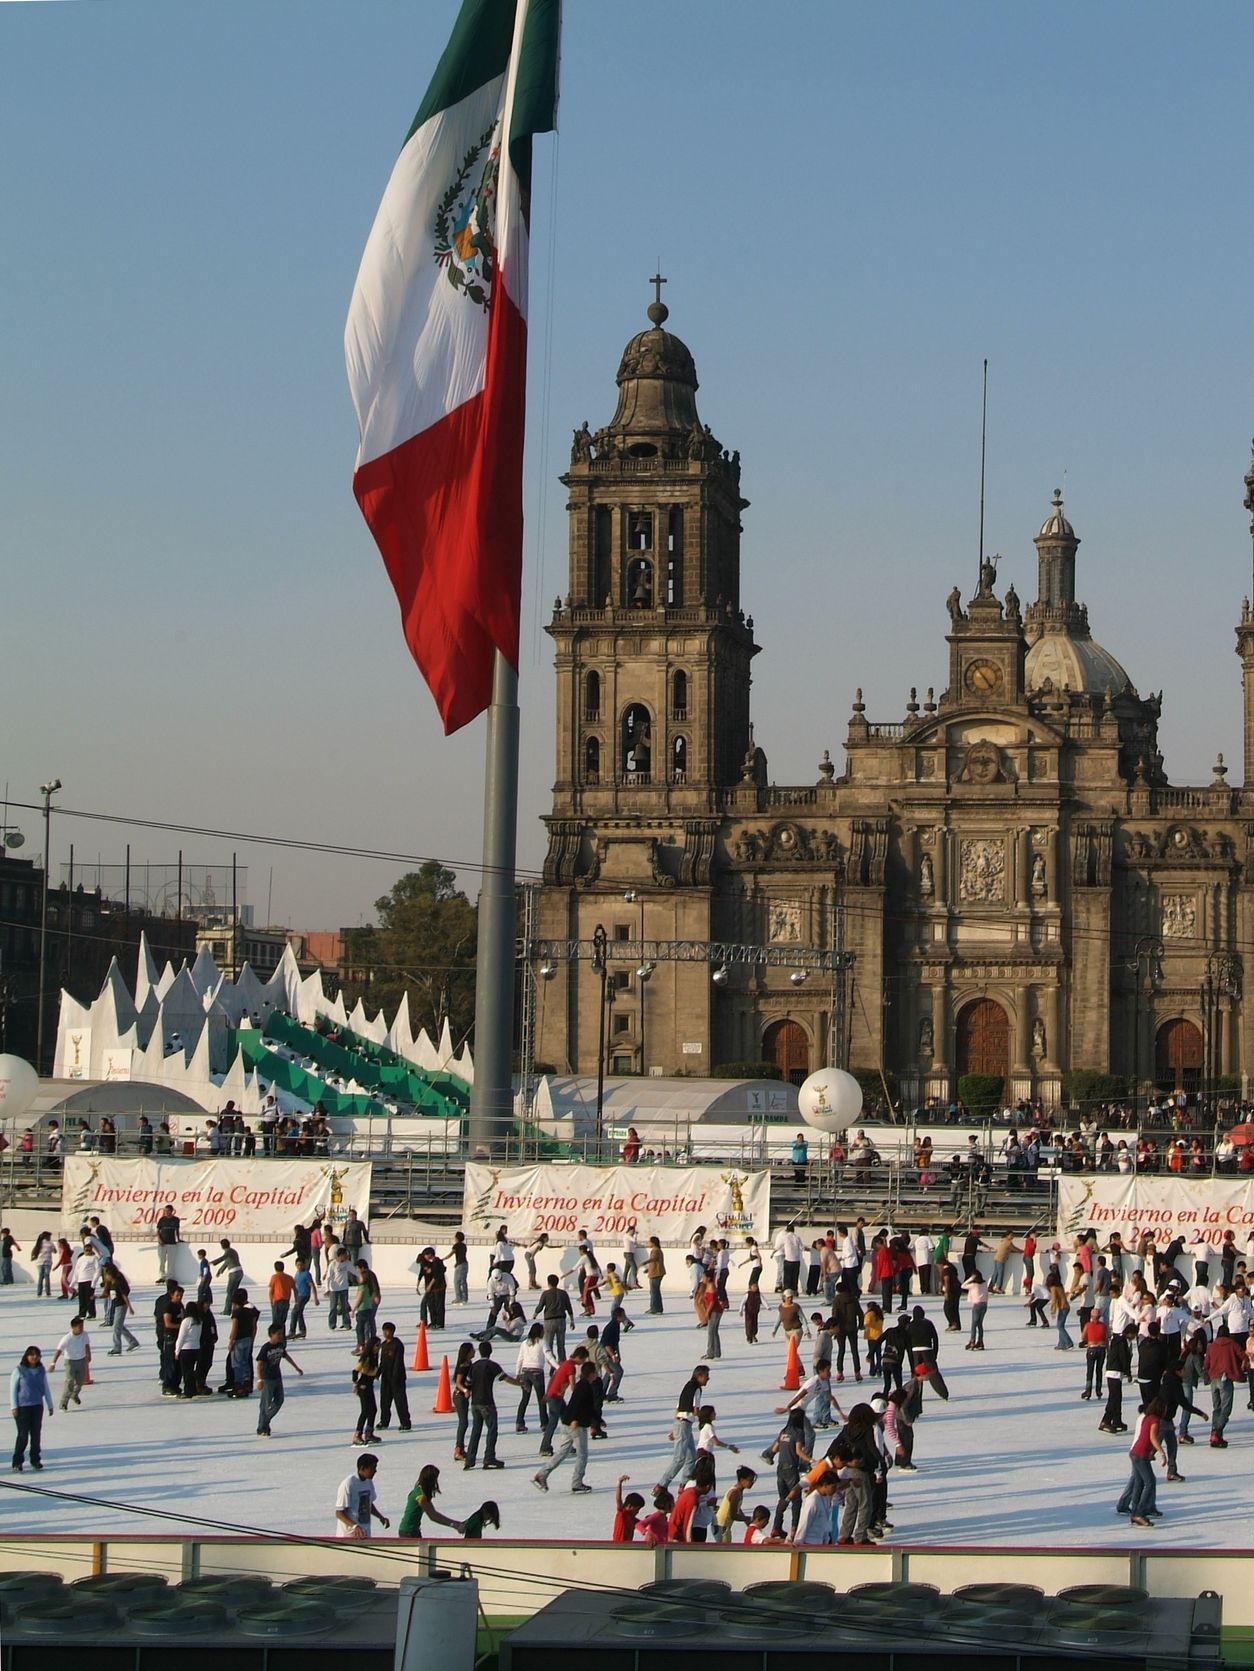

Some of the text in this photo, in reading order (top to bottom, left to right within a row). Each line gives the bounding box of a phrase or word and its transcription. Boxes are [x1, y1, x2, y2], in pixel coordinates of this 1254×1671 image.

[93, 1183, 305, 1210] Invierno en la Capital
[493, 1190, 706, 1216] Invierno en la Capital
[192, 1208, 236, 1226] 2009
[715, 1211, 752, 1221] Ciudad
[1088, 1202, 1173, 1223] Invierno
[1177, 1210, 1197, 1223] en
[1203, 1206, 1220, 1223] la
[534, 1214, 578, 1232] 2008
[1188, 1228, 1225, 1245] 200
